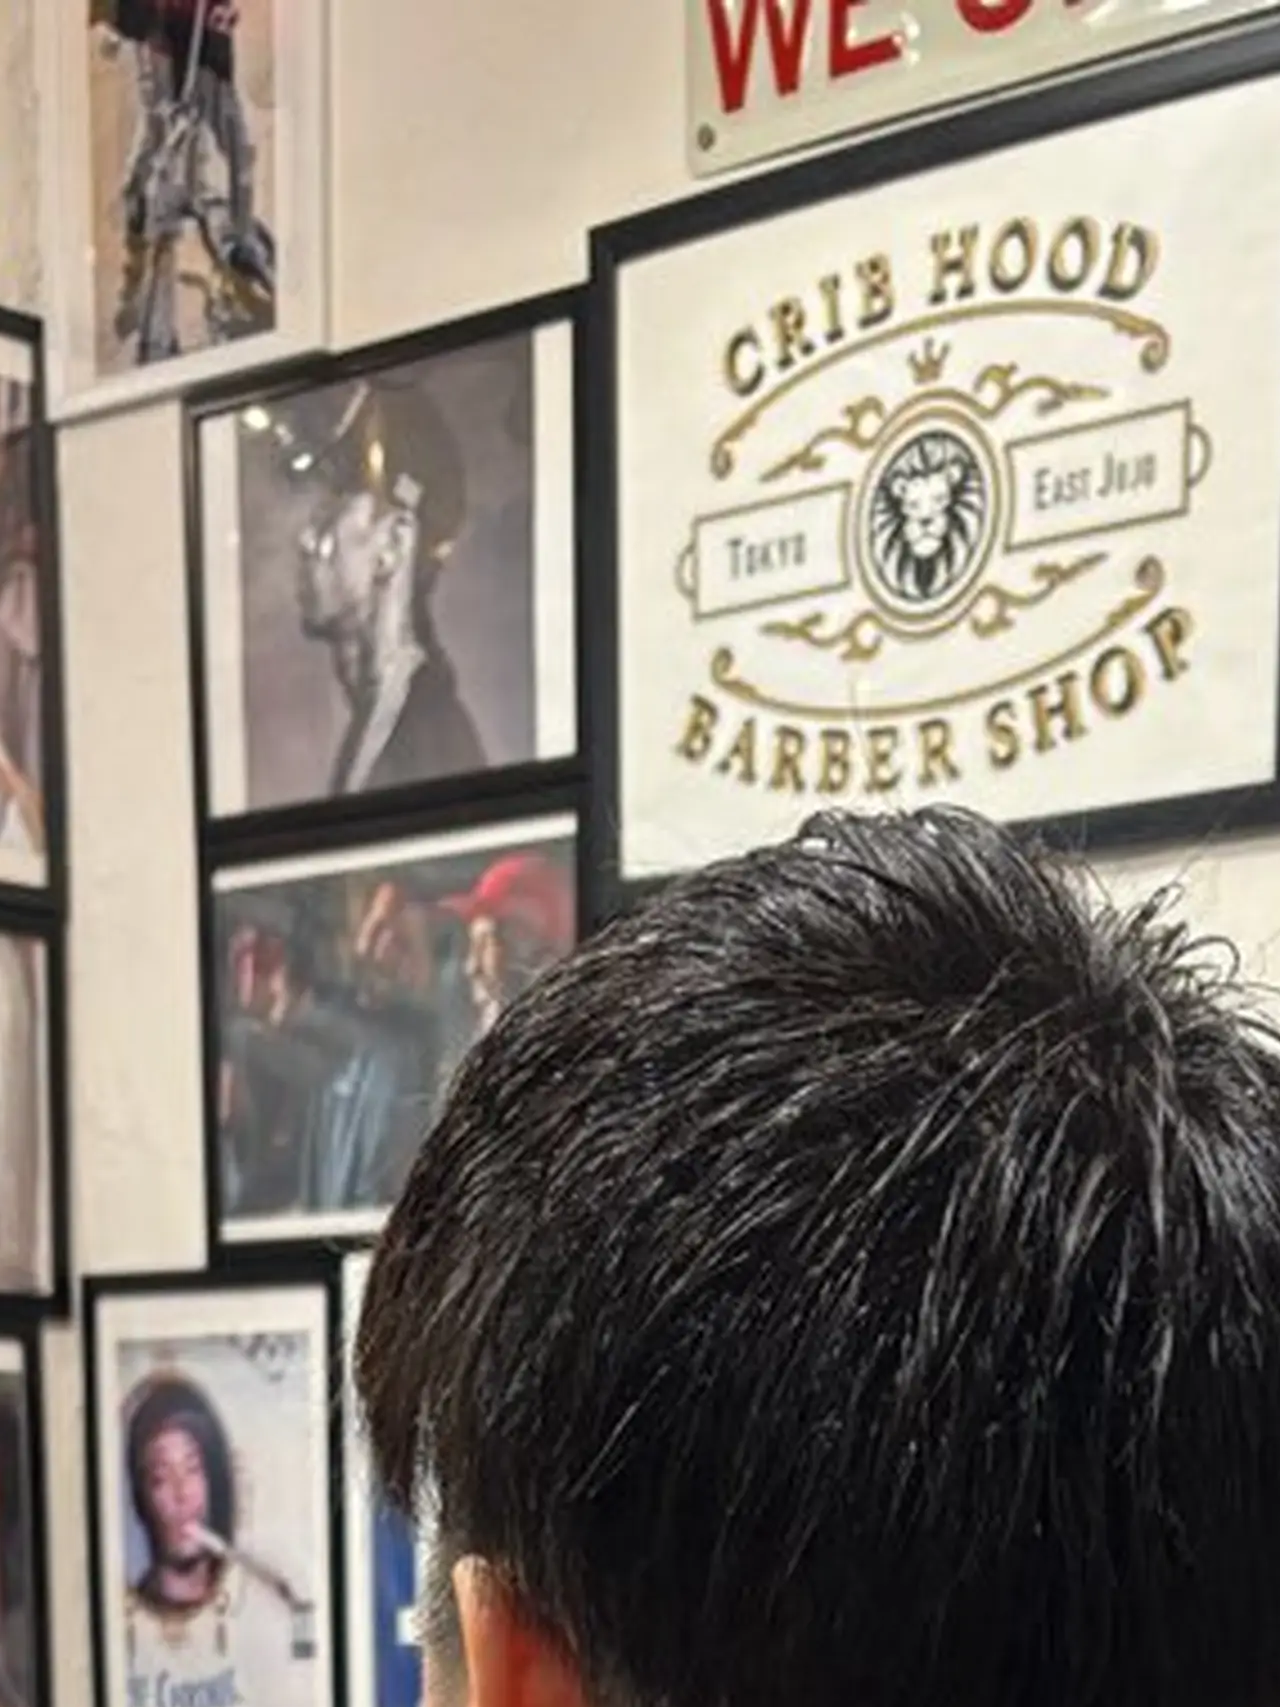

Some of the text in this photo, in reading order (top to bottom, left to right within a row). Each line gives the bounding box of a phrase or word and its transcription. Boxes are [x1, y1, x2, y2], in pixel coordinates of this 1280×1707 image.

[724, 216, 1161, 397] CRIB HOOD
[1033, 467, 1091, 511] EAST
[676, 606, 1196, 795] BARBER SHOP
